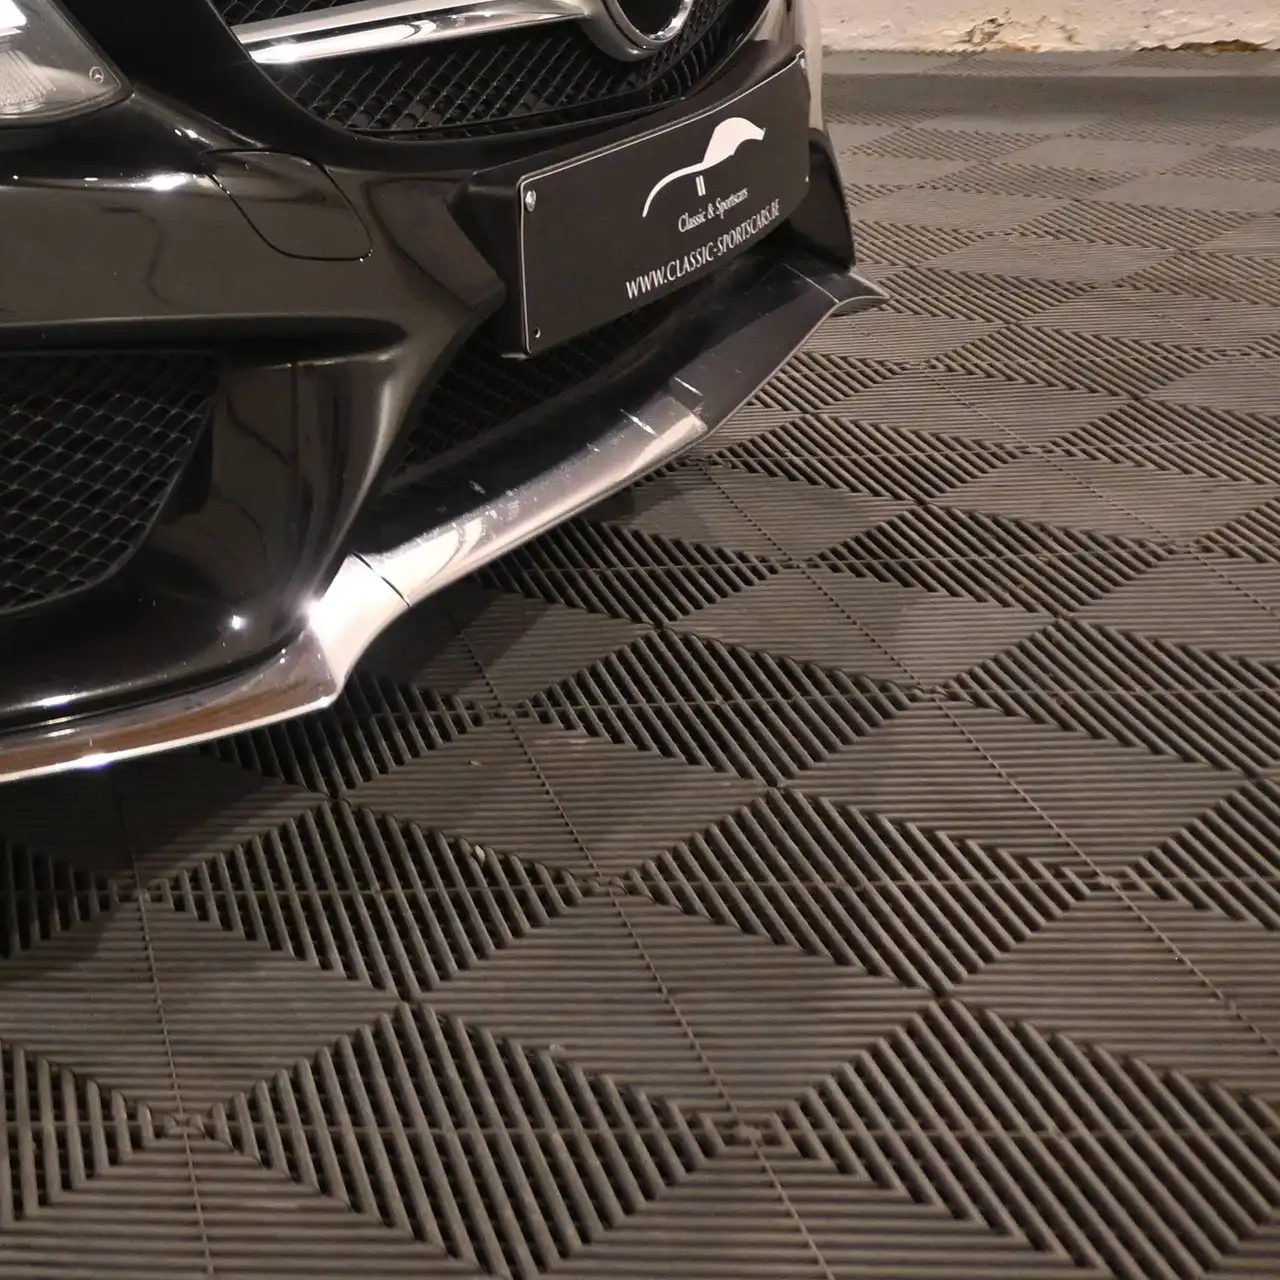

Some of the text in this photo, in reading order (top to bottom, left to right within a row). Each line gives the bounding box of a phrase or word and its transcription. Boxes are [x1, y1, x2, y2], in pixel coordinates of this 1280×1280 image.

[677, 208, 708, 233] Classic
[715, 187, 749, 220] Sportscars
[624, 197, 781, 301] WWW.CLASSIC-SPORTSCARS.BE
